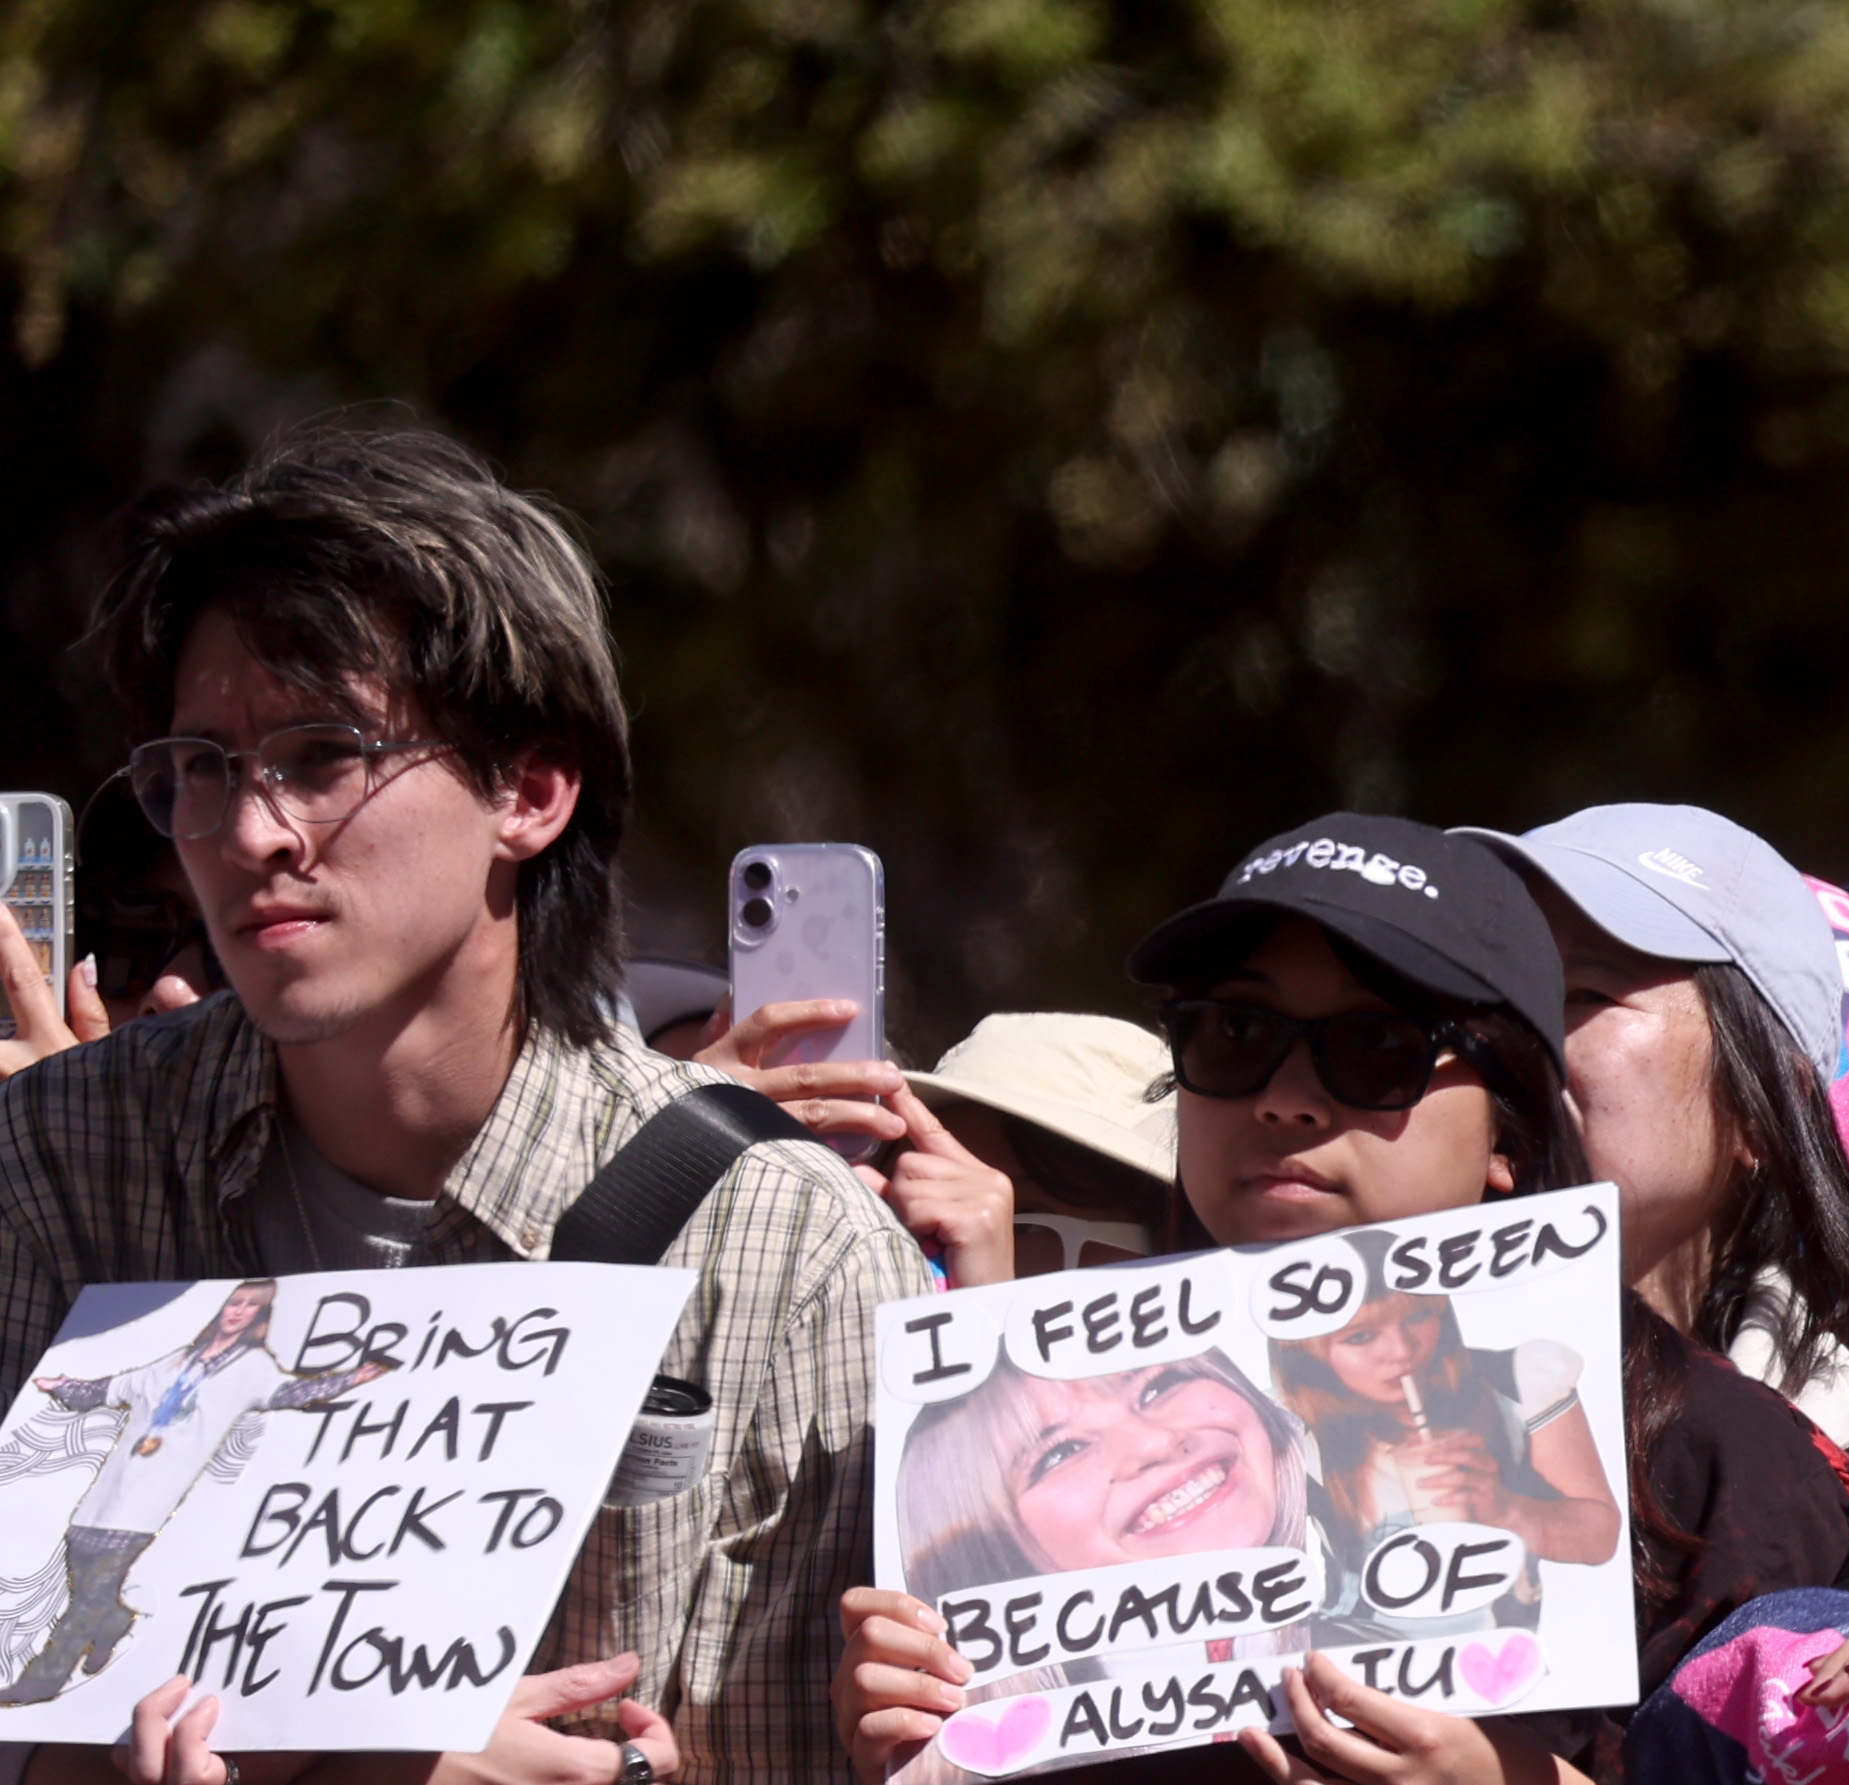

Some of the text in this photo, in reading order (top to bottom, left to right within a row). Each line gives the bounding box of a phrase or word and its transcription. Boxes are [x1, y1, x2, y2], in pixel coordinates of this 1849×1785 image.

[1653, 847, 1704, 880] NIKE
[904, 1205, 1608, 1386] I FEEL SO SEEN
[304, 1401, 536, 1464] THAT
[239, 1483, 566, 1567] BACK TO
[179, 1579, 517, 1697] THE TOWN
[944, 1534, 1512, 1674] BECAUSE OF
[1060, 1648, 1456, 1751] ALYSA IU
